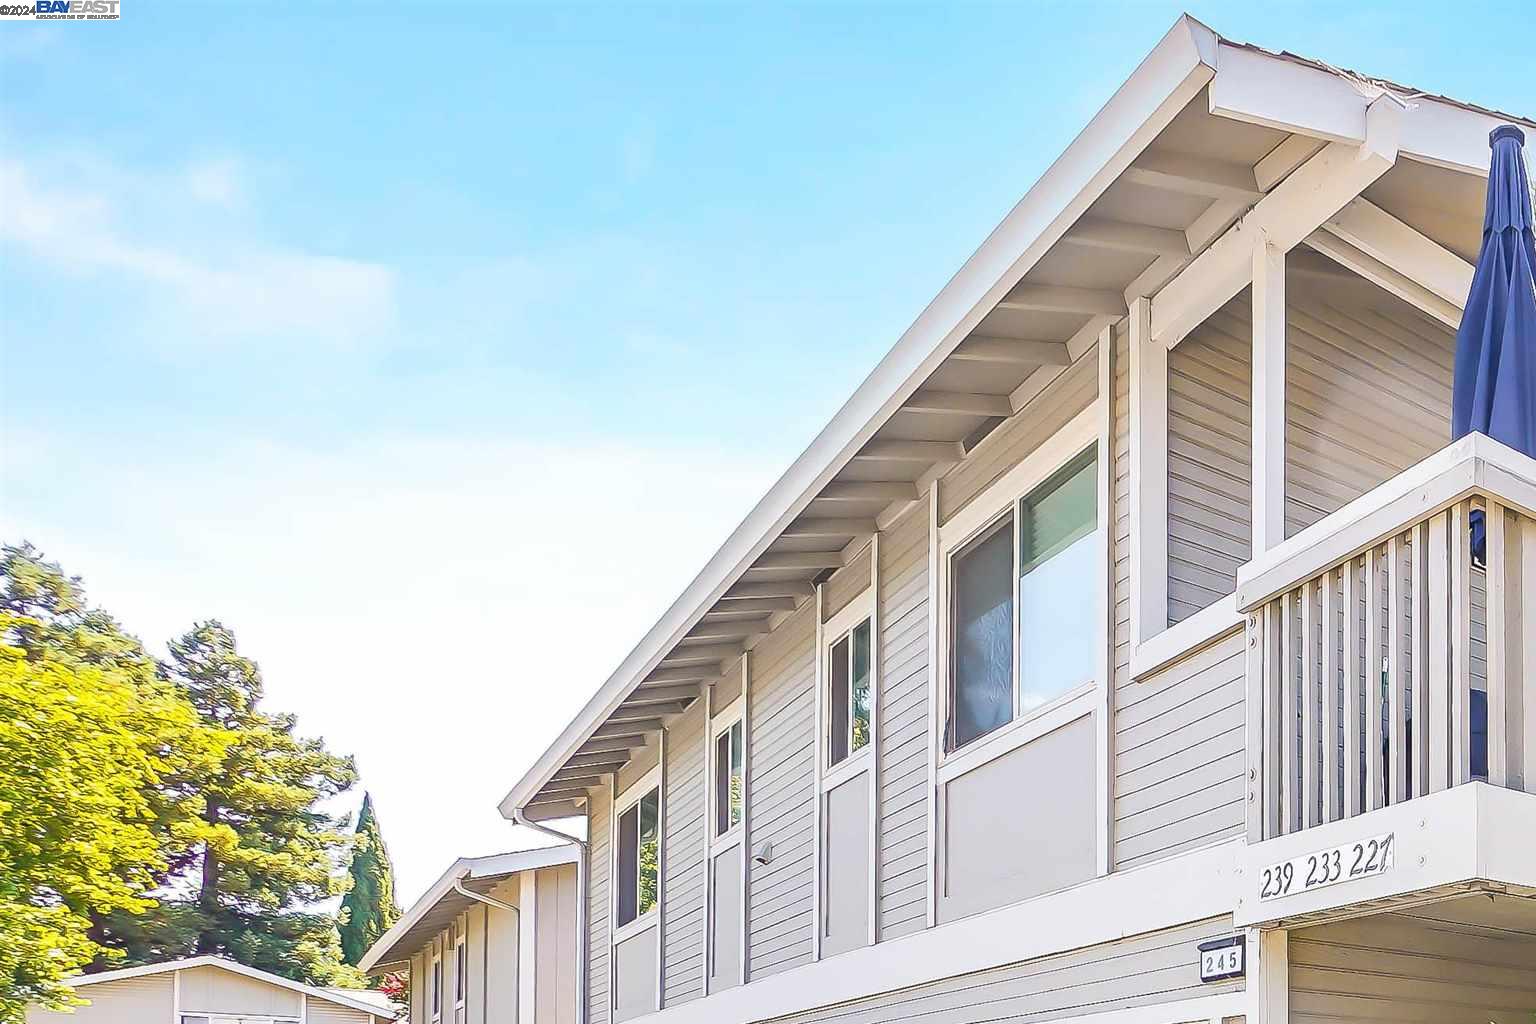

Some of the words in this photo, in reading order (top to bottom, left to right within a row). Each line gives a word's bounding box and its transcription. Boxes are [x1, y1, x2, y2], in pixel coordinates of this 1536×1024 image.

[1261, 862, 1293, 899] 239
[1305, 850, 1341, 888] 233
[1349, 832, 1393, 877] 227
[1206, 951, 1237, 973] 245
